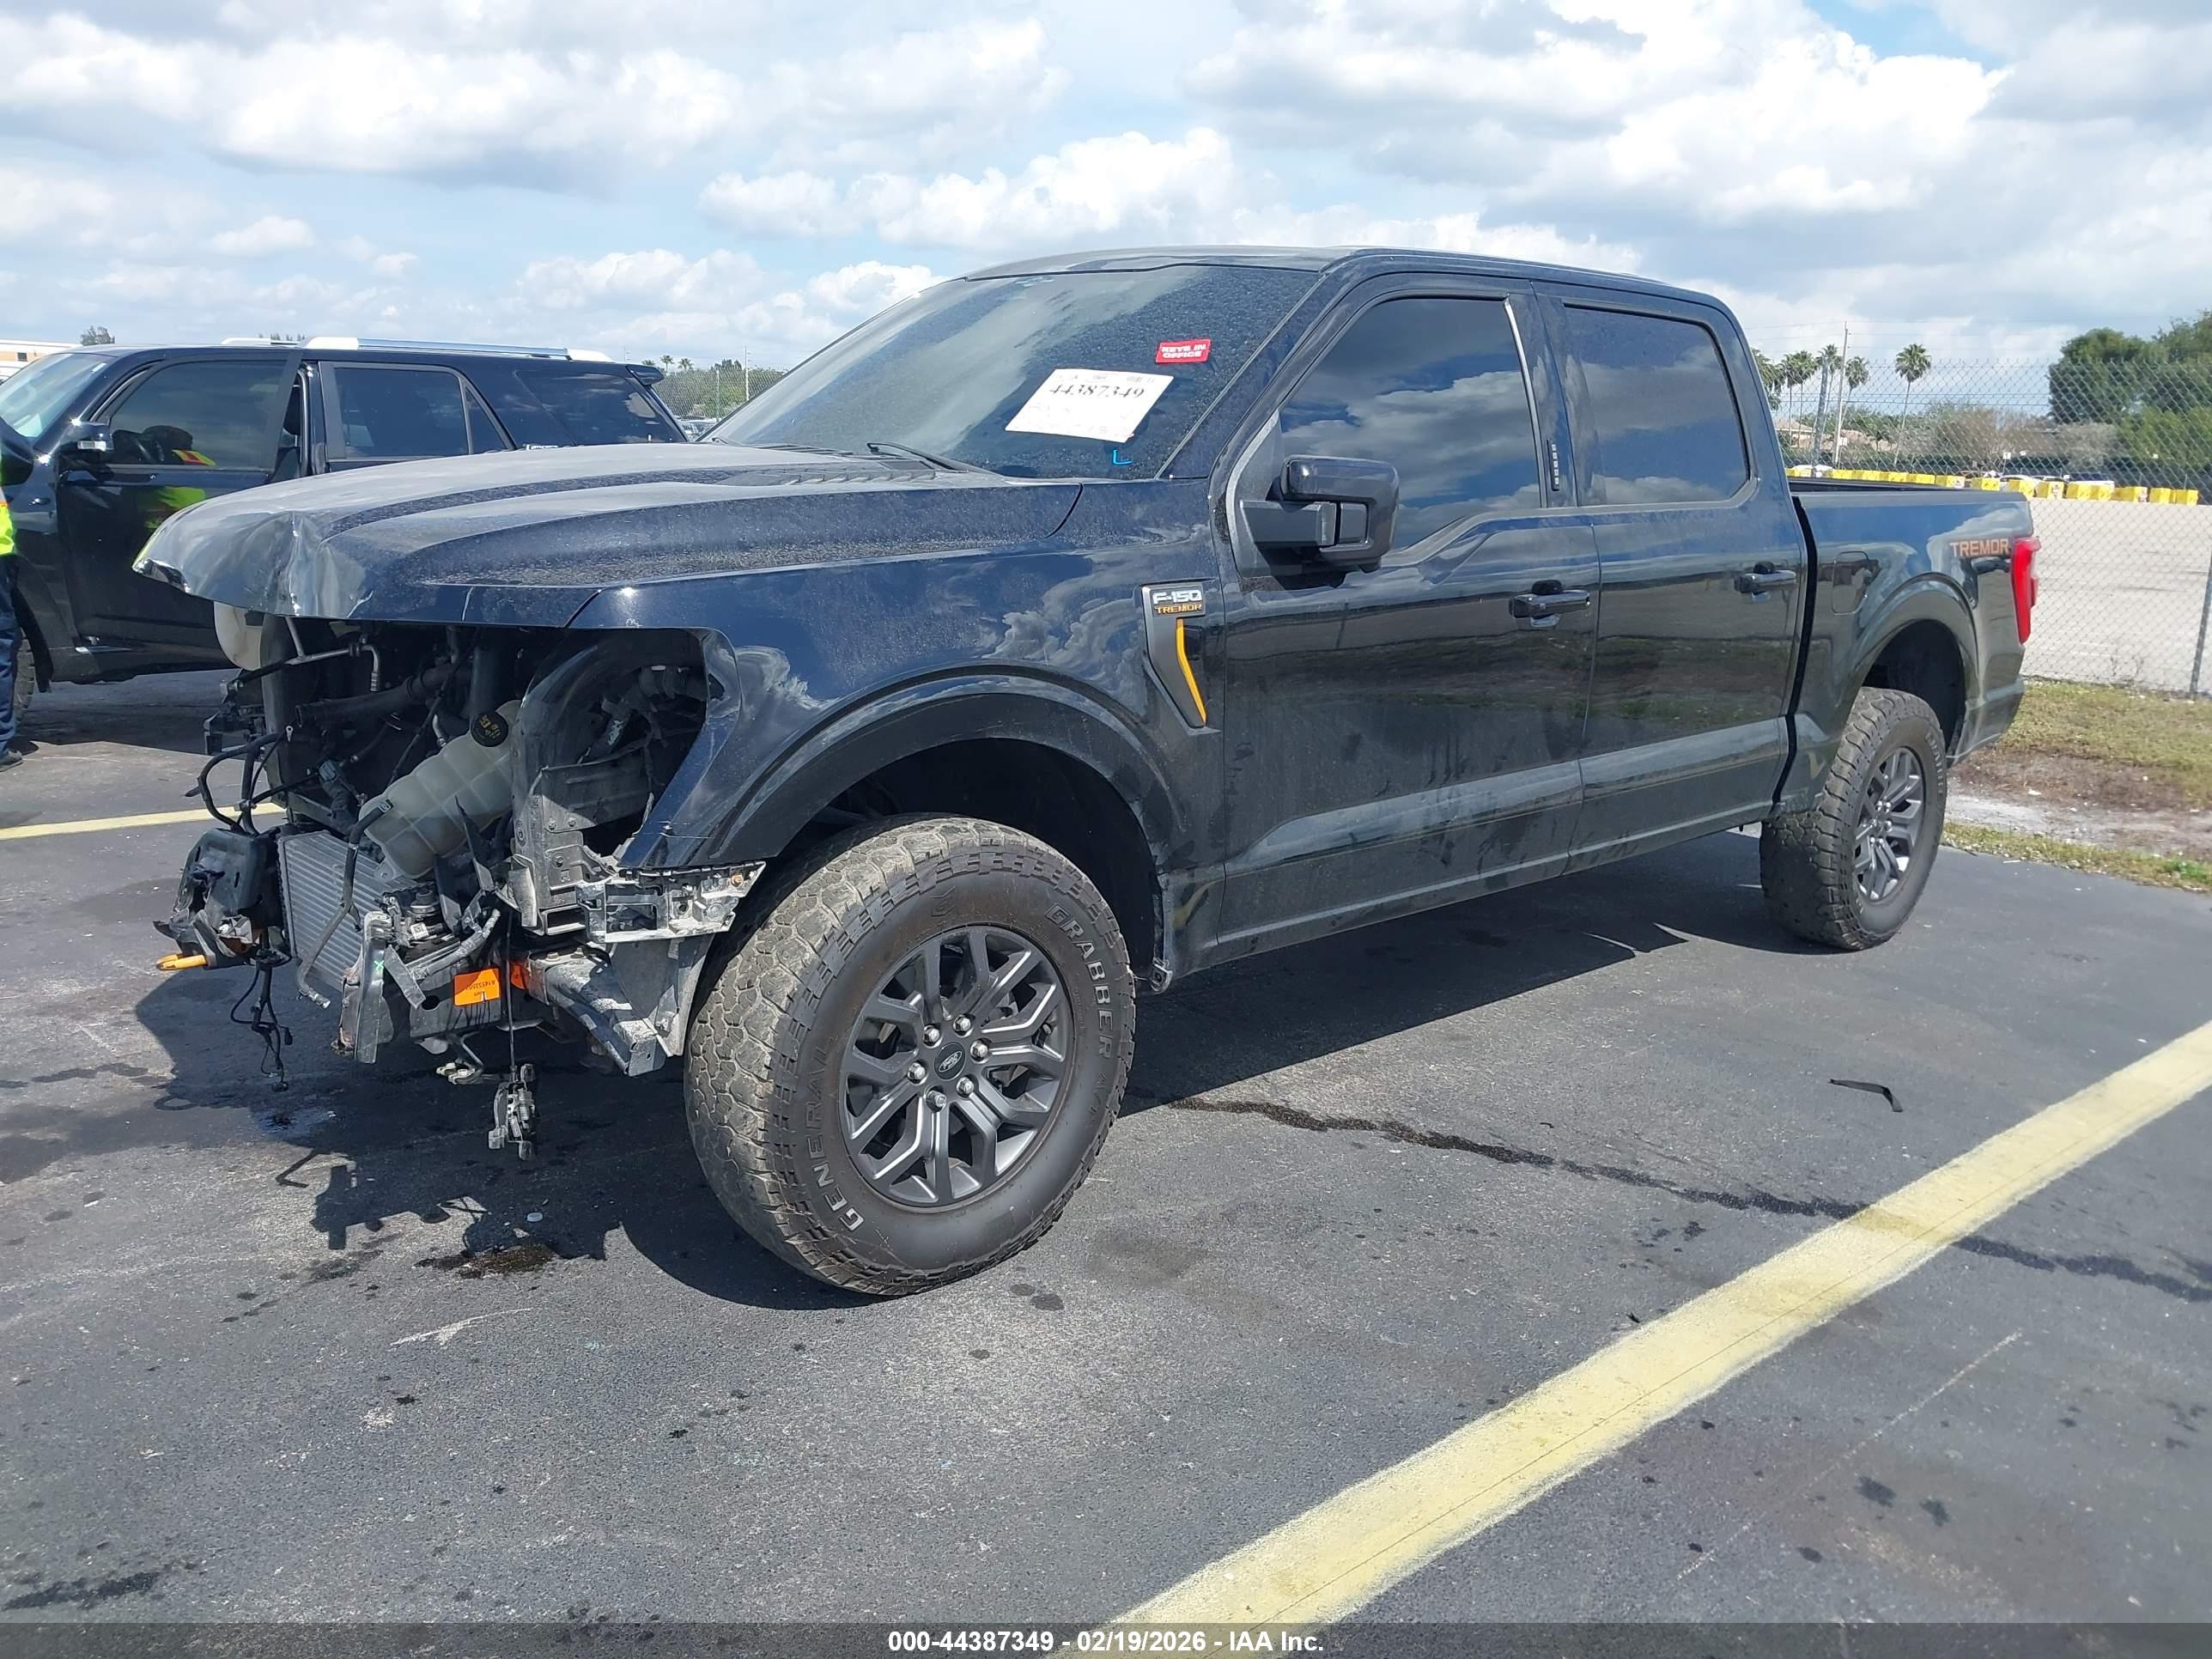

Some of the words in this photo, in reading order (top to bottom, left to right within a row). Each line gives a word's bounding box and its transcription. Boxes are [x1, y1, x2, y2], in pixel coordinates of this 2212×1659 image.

[1949, 538, 2009, 557] TREMOR
[1152, 590, 1202, 605] F-150
[1155, 604, 1202, 614] TREMOR
[1044, 904, 1114, 1060] GRABBER
[805, 1045, 865, 1232] GENERAL
